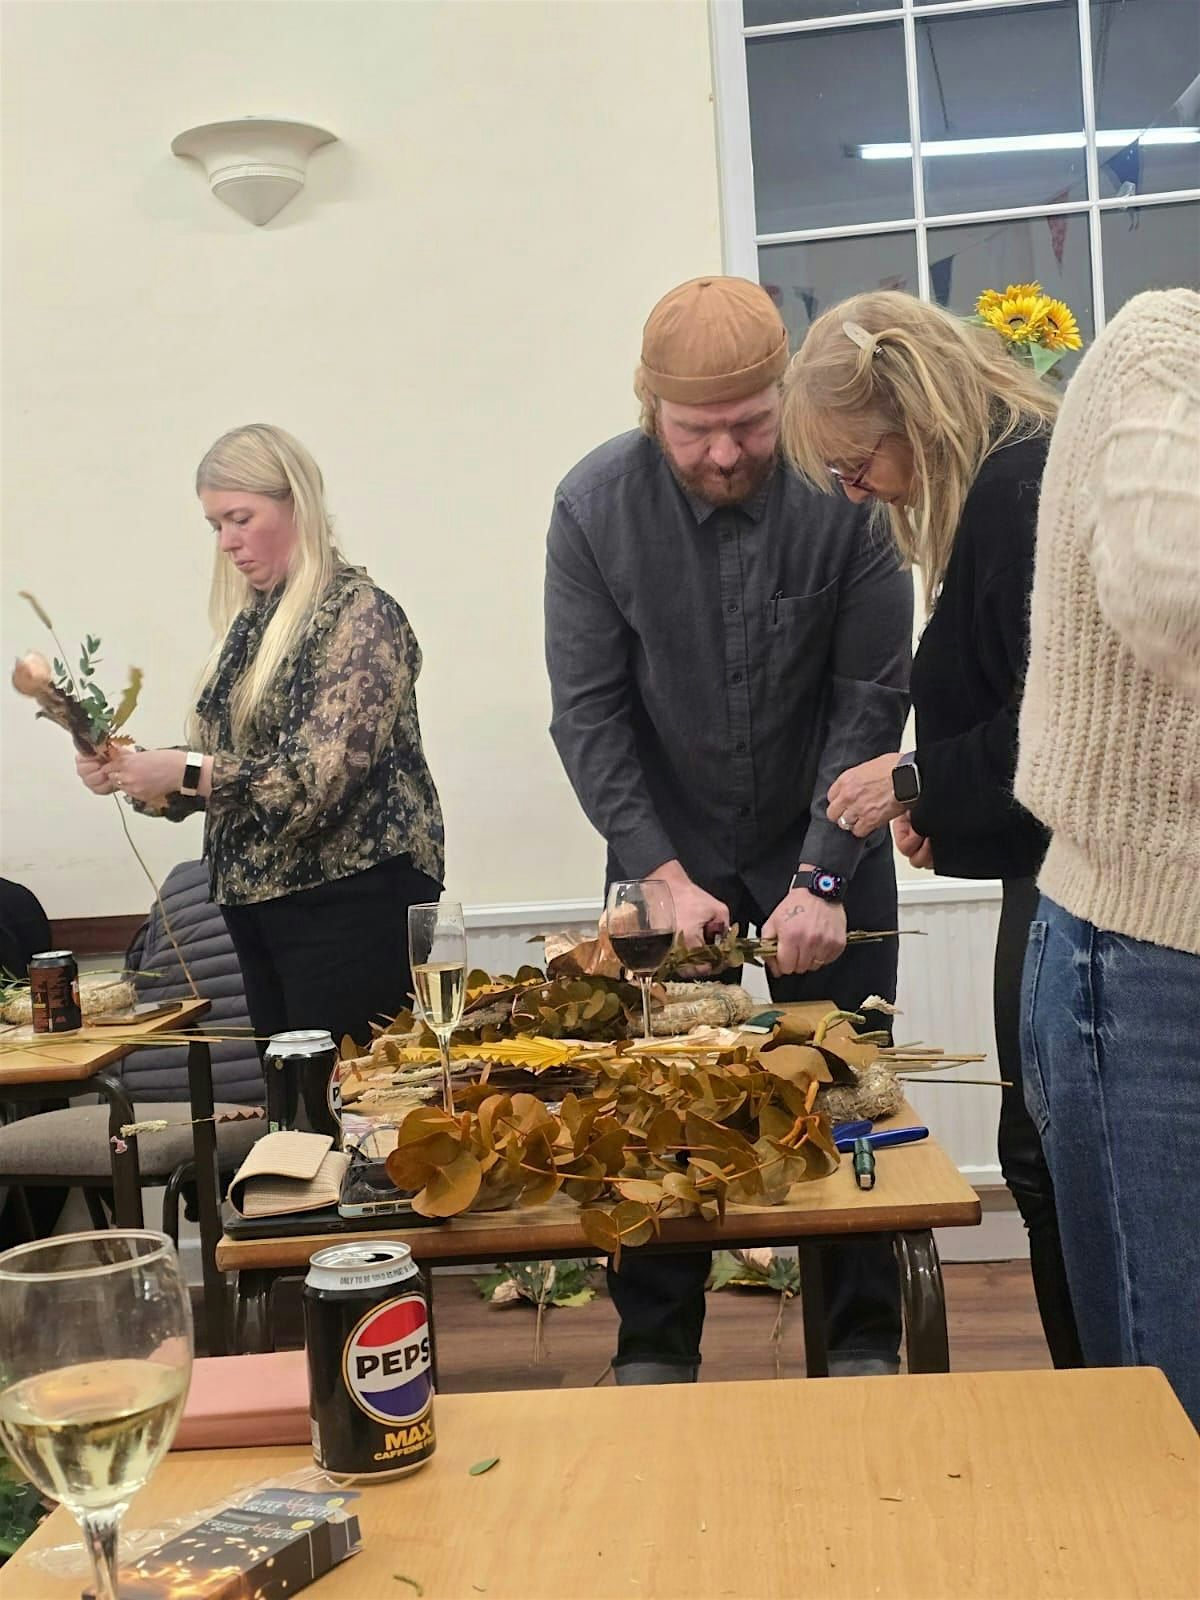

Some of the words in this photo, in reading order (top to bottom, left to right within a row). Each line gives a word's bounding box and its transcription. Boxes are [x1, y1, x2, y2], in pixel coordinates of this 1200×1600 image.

[340, 1276, 354, 1285] ONLY
[355, 1276, 363, 1284] TO
[364, 1275, 371, 1283] BE
[356, 1337, 430, 1379] PEPS
[385, 1420, 432, 1451] MAX
